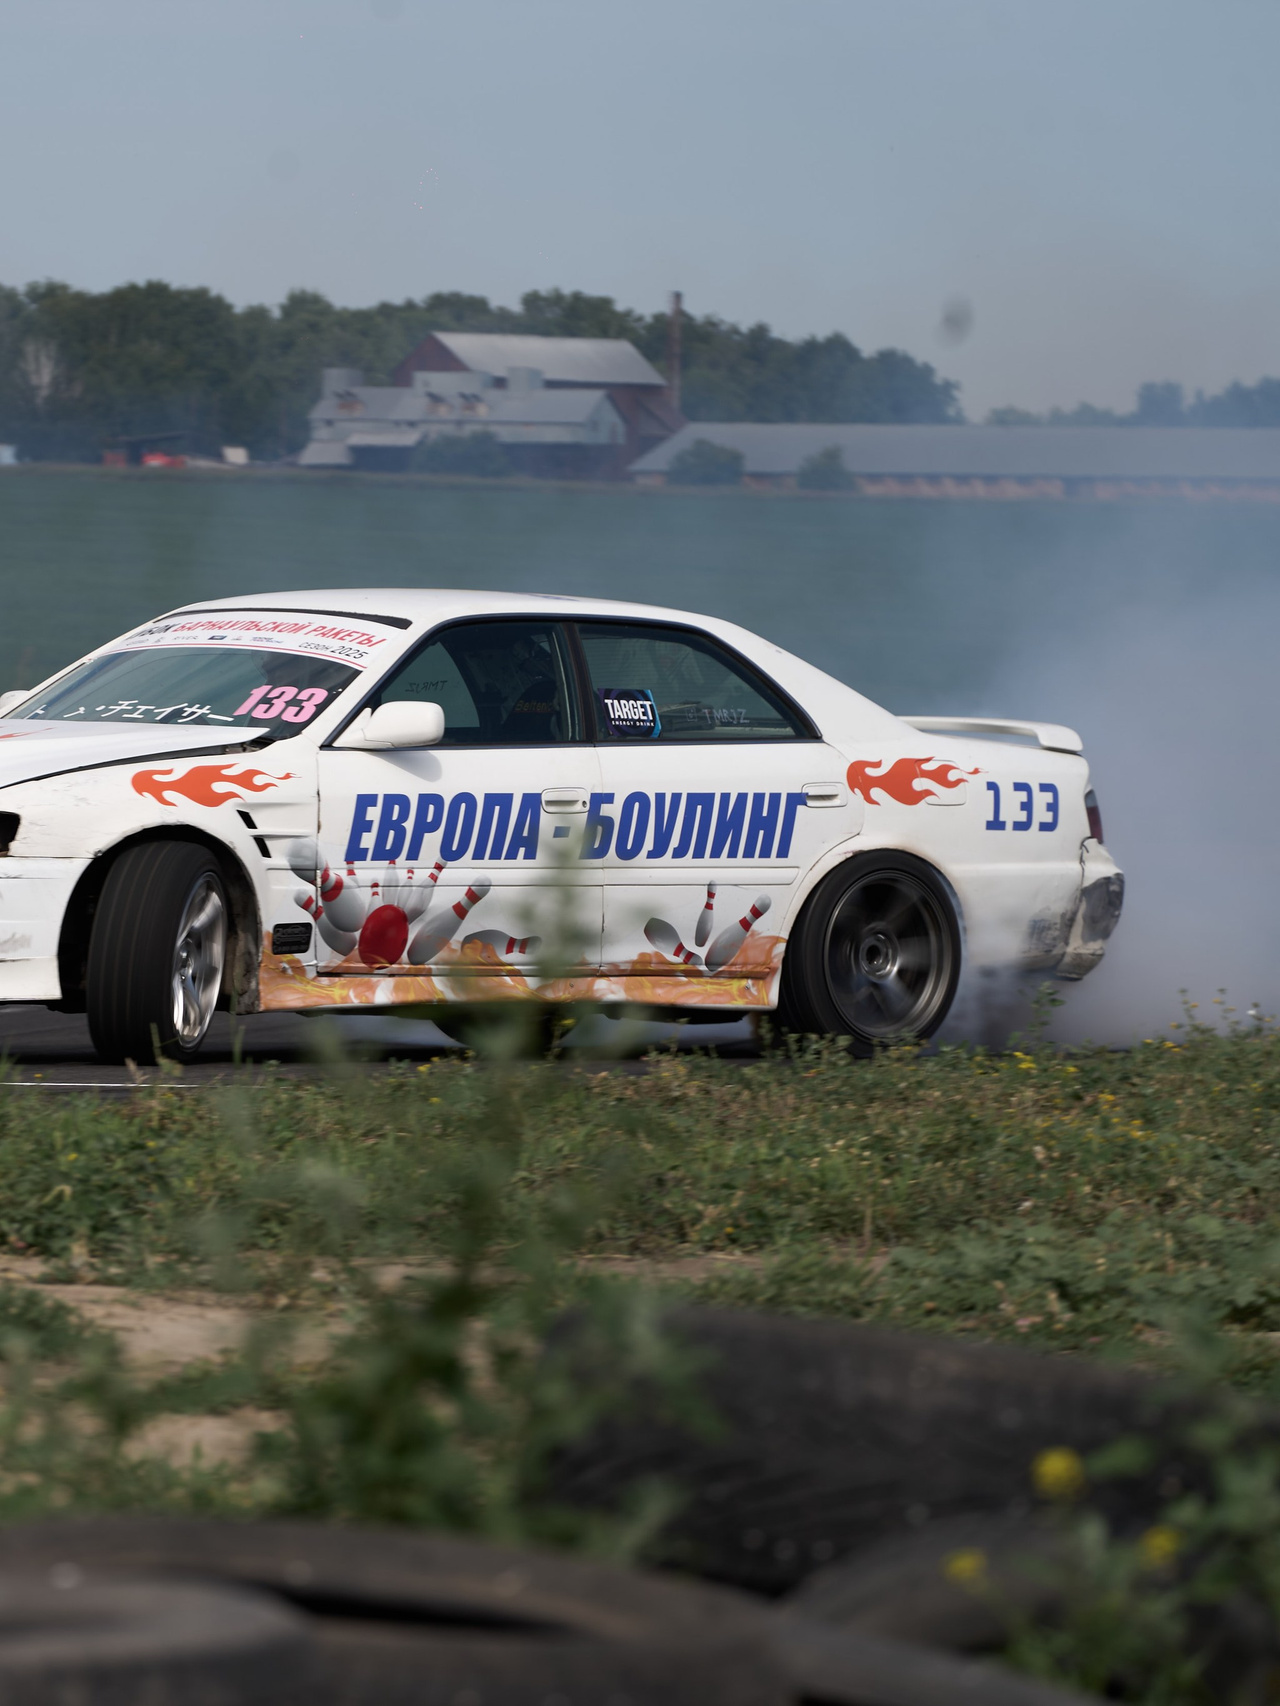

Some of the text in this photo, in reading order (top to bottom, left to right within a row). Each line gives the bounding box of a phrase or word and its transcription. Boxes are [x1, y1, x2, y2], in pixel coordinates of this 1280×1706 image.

[172, 620, 312, 635] БАРНАУЛЬСКОЙ
[304, 625, 388, 648] РАКЕТЫ
[298, 641, 369, 660] СЕЗОН 2025
[233, 684, 328, 723] 133
[604, 699, 654, 721] TARGET
[985, 781, 1060, 832] 133
[344, 791, 542, 862] ЕВРОПА
[578, 791, 810, 861] БОУЛИНГ
